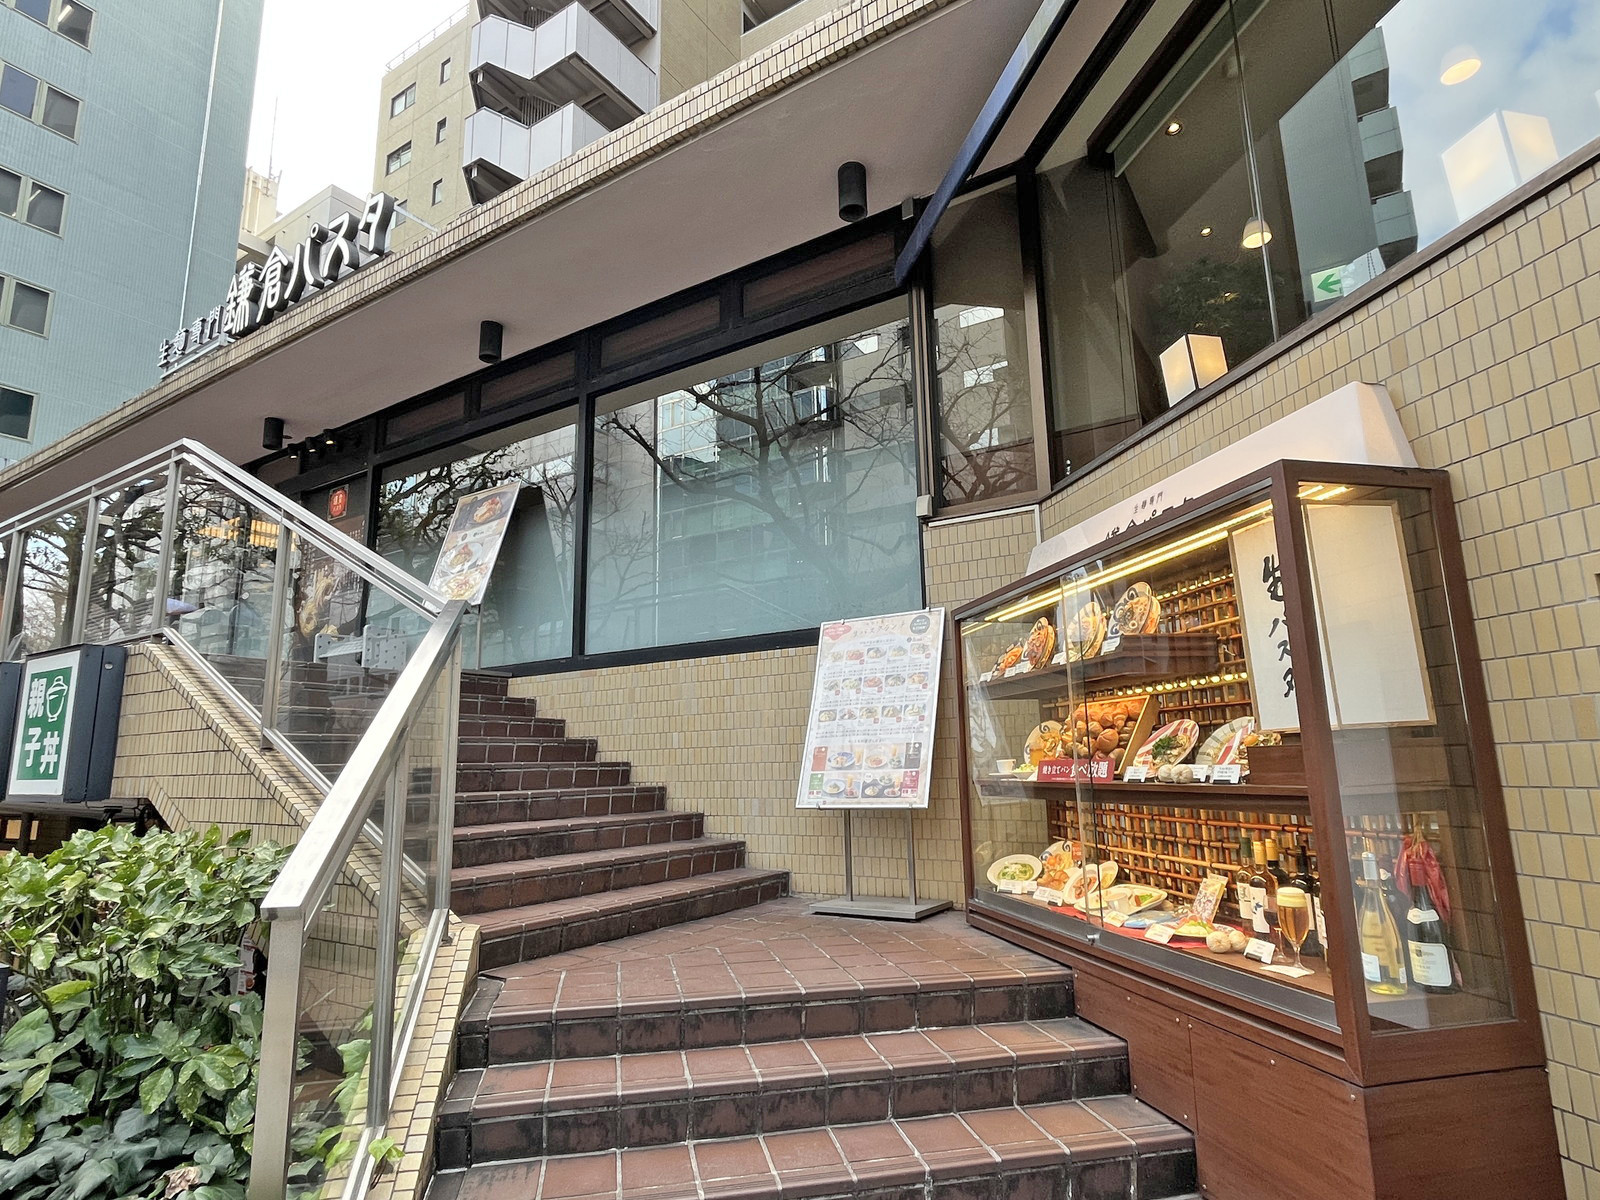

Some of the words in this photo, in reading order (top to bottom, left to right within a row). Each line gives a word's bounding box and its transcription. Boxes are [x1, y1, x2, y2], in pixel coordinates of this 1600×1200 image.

[224, 191, 393, 336] 鎌倉パスタ
[24, 677, 60, 775] 親子丼
